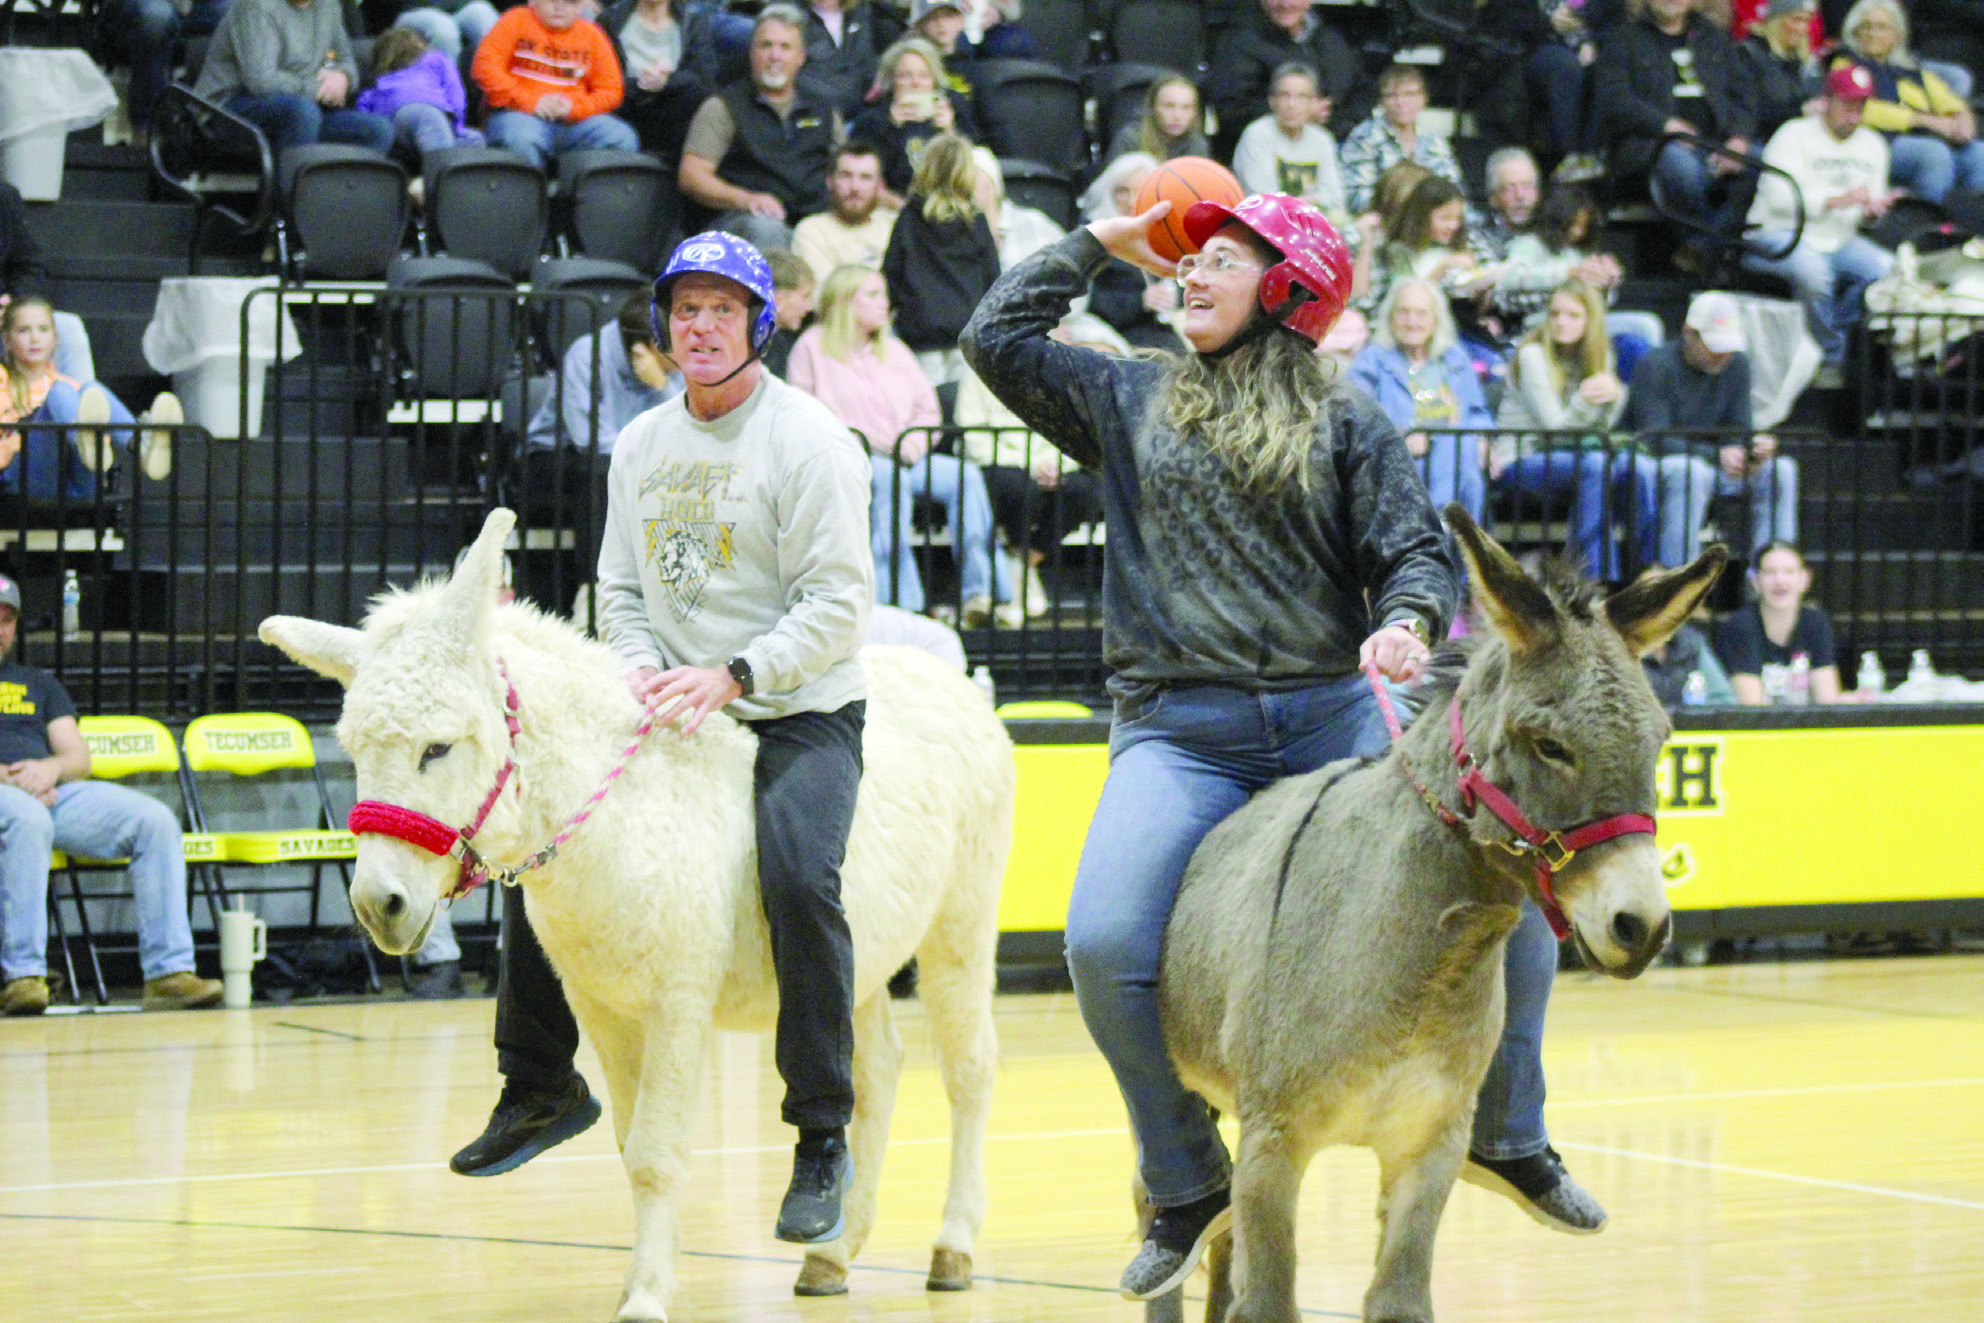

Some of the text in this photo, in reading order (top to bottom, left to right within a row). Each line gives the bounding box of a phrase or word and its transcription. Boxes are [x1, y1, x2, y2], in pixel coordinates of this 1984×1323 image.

[85, 733, 156, 755] CUMSEH
[204, 730, 292, 751] TECUMSEH
[280, 838, 356, 855] SAVAGES
